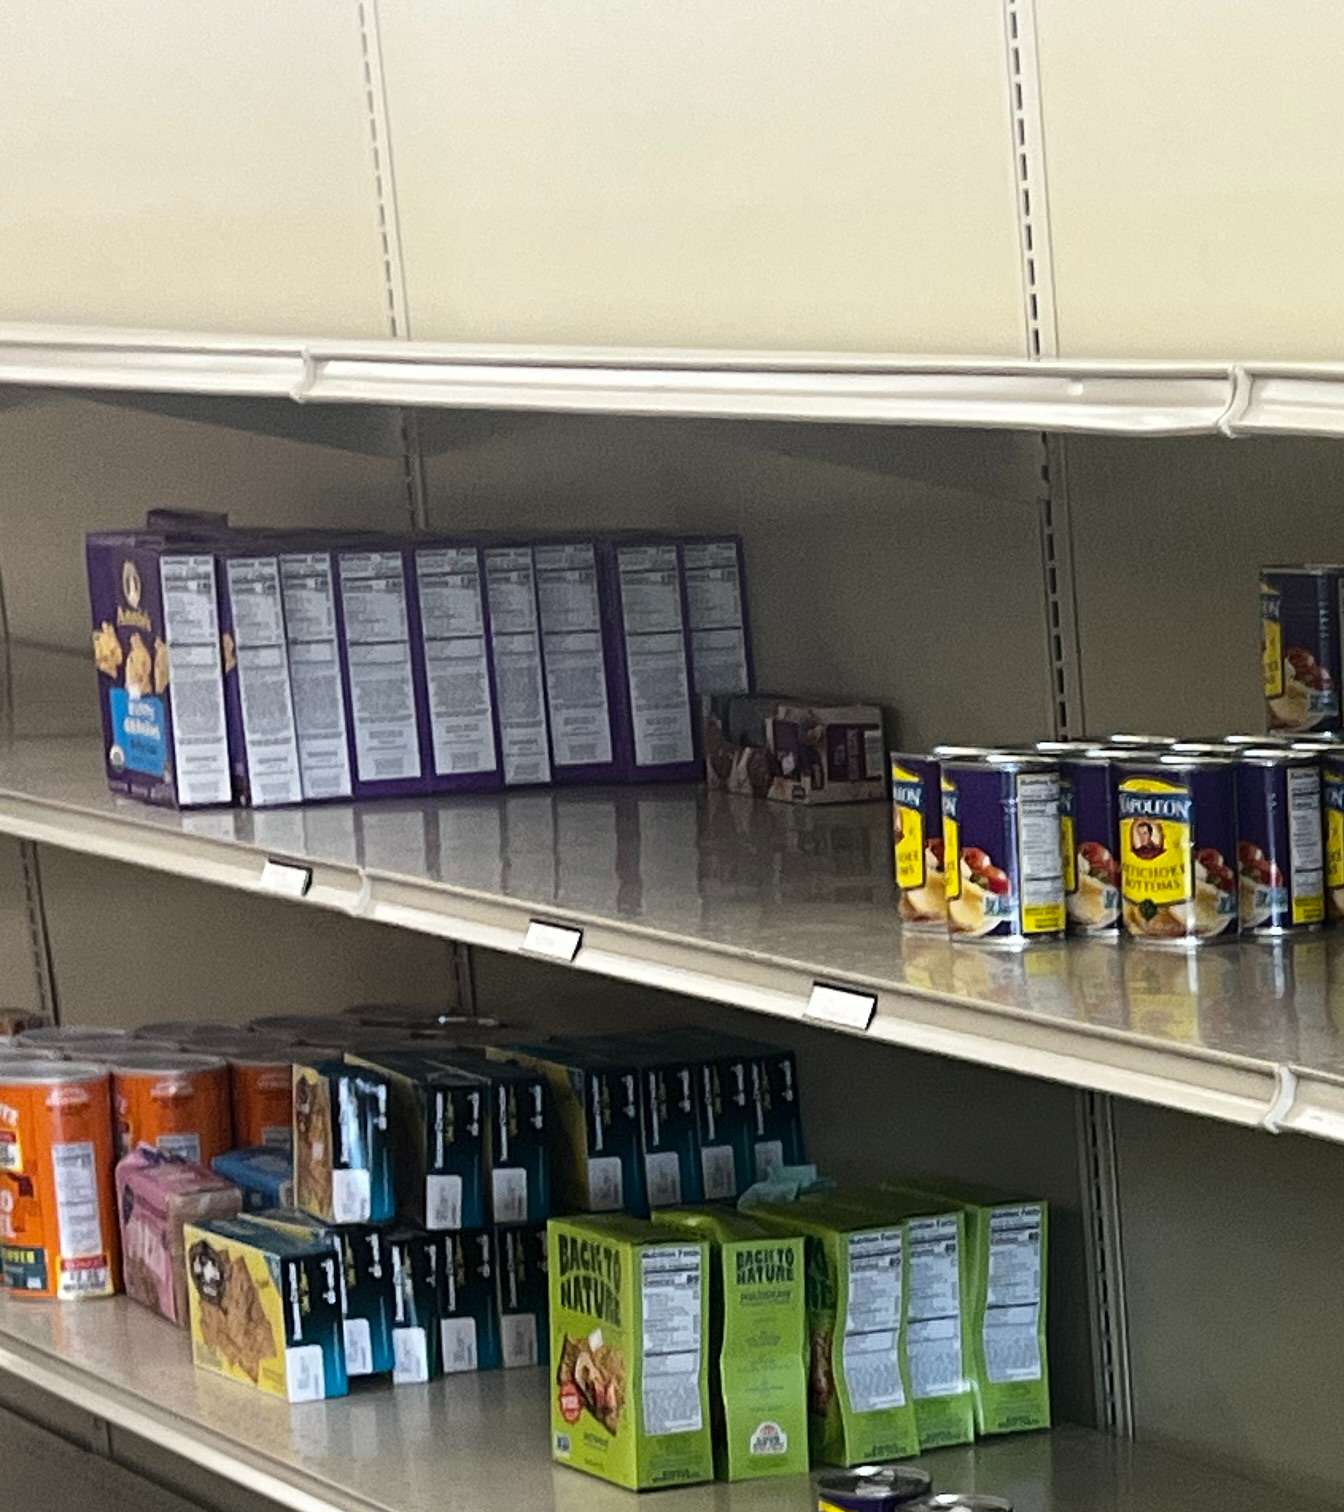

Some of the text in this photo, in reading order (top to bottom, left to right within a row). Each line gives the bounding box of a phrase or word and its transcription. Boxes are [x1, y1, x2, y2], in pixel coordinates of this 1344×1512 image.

[736, 1247, 795, 1272] BACK TO
[736, 1263, 795, 1287] NATURE
